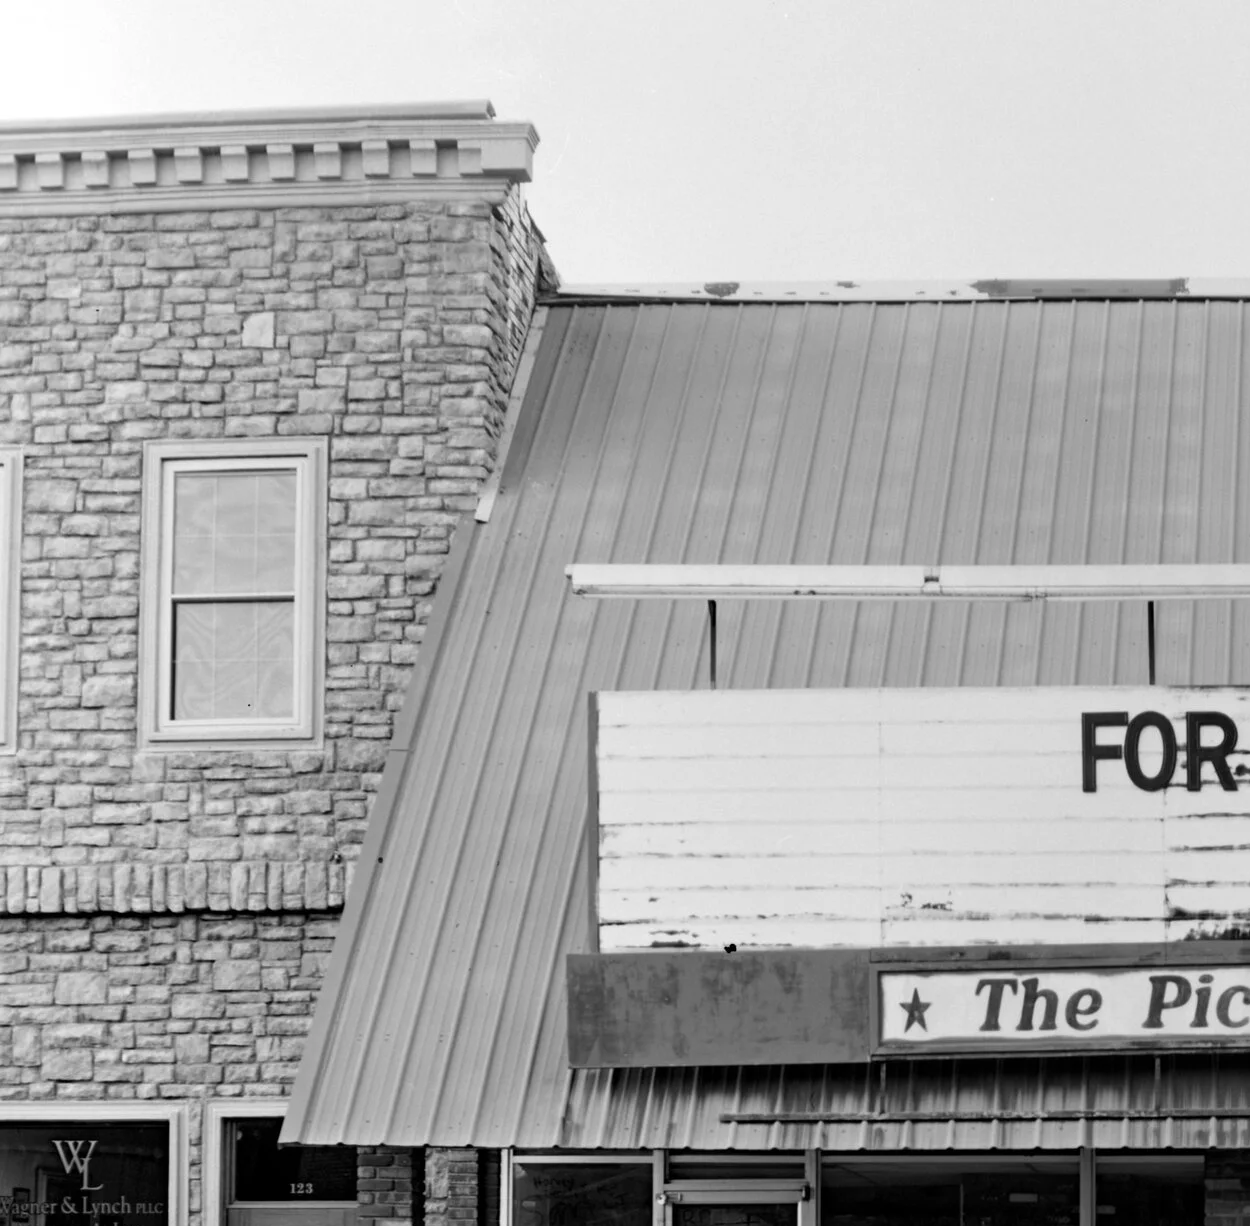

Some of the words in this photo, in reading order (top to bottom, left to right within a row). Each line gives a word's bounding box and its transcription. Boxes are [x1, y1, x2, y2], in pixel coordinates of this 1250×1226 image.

[1081, 711, 1239, 792] FOR
[975, 977, 1103, 1033] The
[61, 1196, 78, 1215] &
[82, 1195, 132, 1218] Lynch
[136, 1203, 164, 1214] PLLC
[289, 1183, 314, 1194] 123
